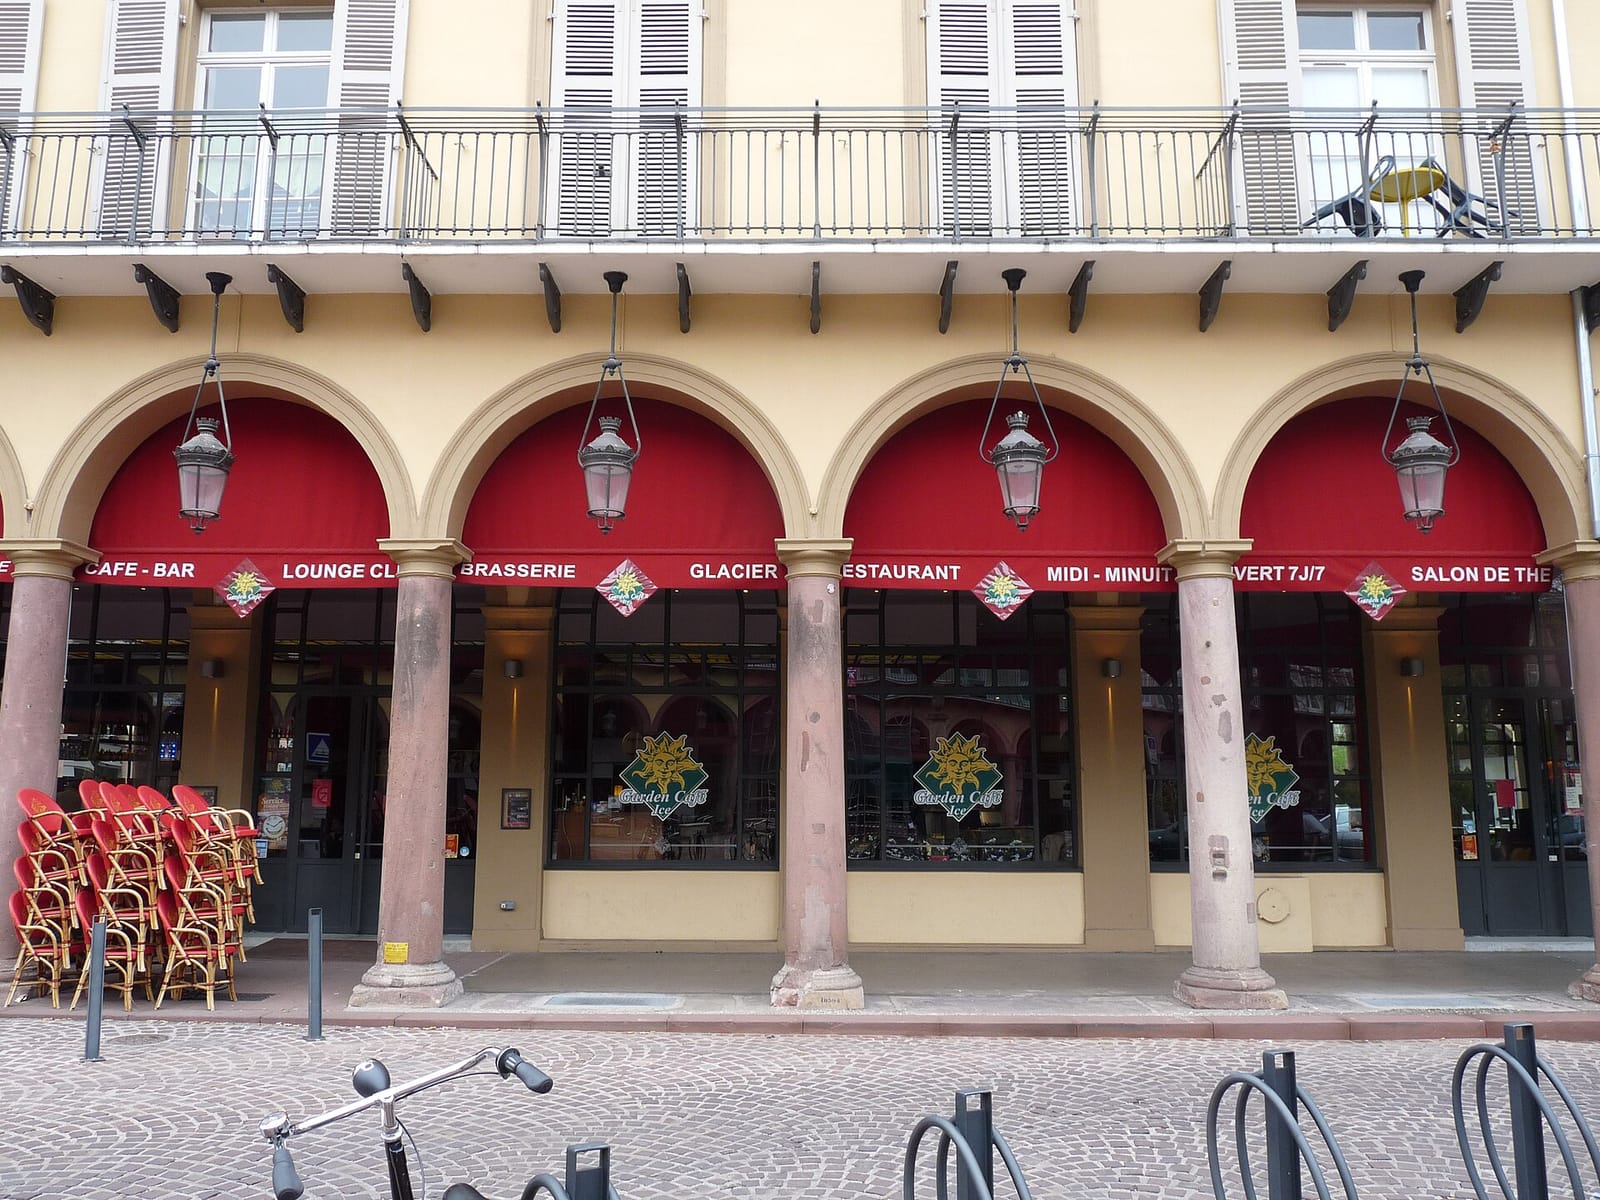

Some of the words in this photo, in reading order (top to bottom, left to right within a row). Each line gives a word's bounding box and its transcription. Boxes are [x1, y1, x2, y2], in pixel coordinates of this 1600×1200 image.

[84, 562, 138, 577] CAFE
[153, 562, 195, 578] BAR
[282, 563, 365, 579] LOUNGE
[370, 563, 400, 579] CL
[460, 562, 577, 579] BRASSERIE
[689, 563, 778, 579] GLACIER
[842, 563, 961, 581] ESTAURANT
[1047, 566, 1089, 582] MIDI
[1105, 566, 1173, 583] MINUIT
[1231, 566, 1284, 582] VERT
[1288, 565, 1326, 582] 7J/7
[1411, 566, 1479, 582] SALON
[1484, 567, 1510, 582] DE
[1514, 567, 1551, 583] THE
[619, 789, 669, 804] Garden
[914, 789, 965, 804] Garden
[651, 804, 671, 816] Ice
[946, 805, 967, 817] Ice
